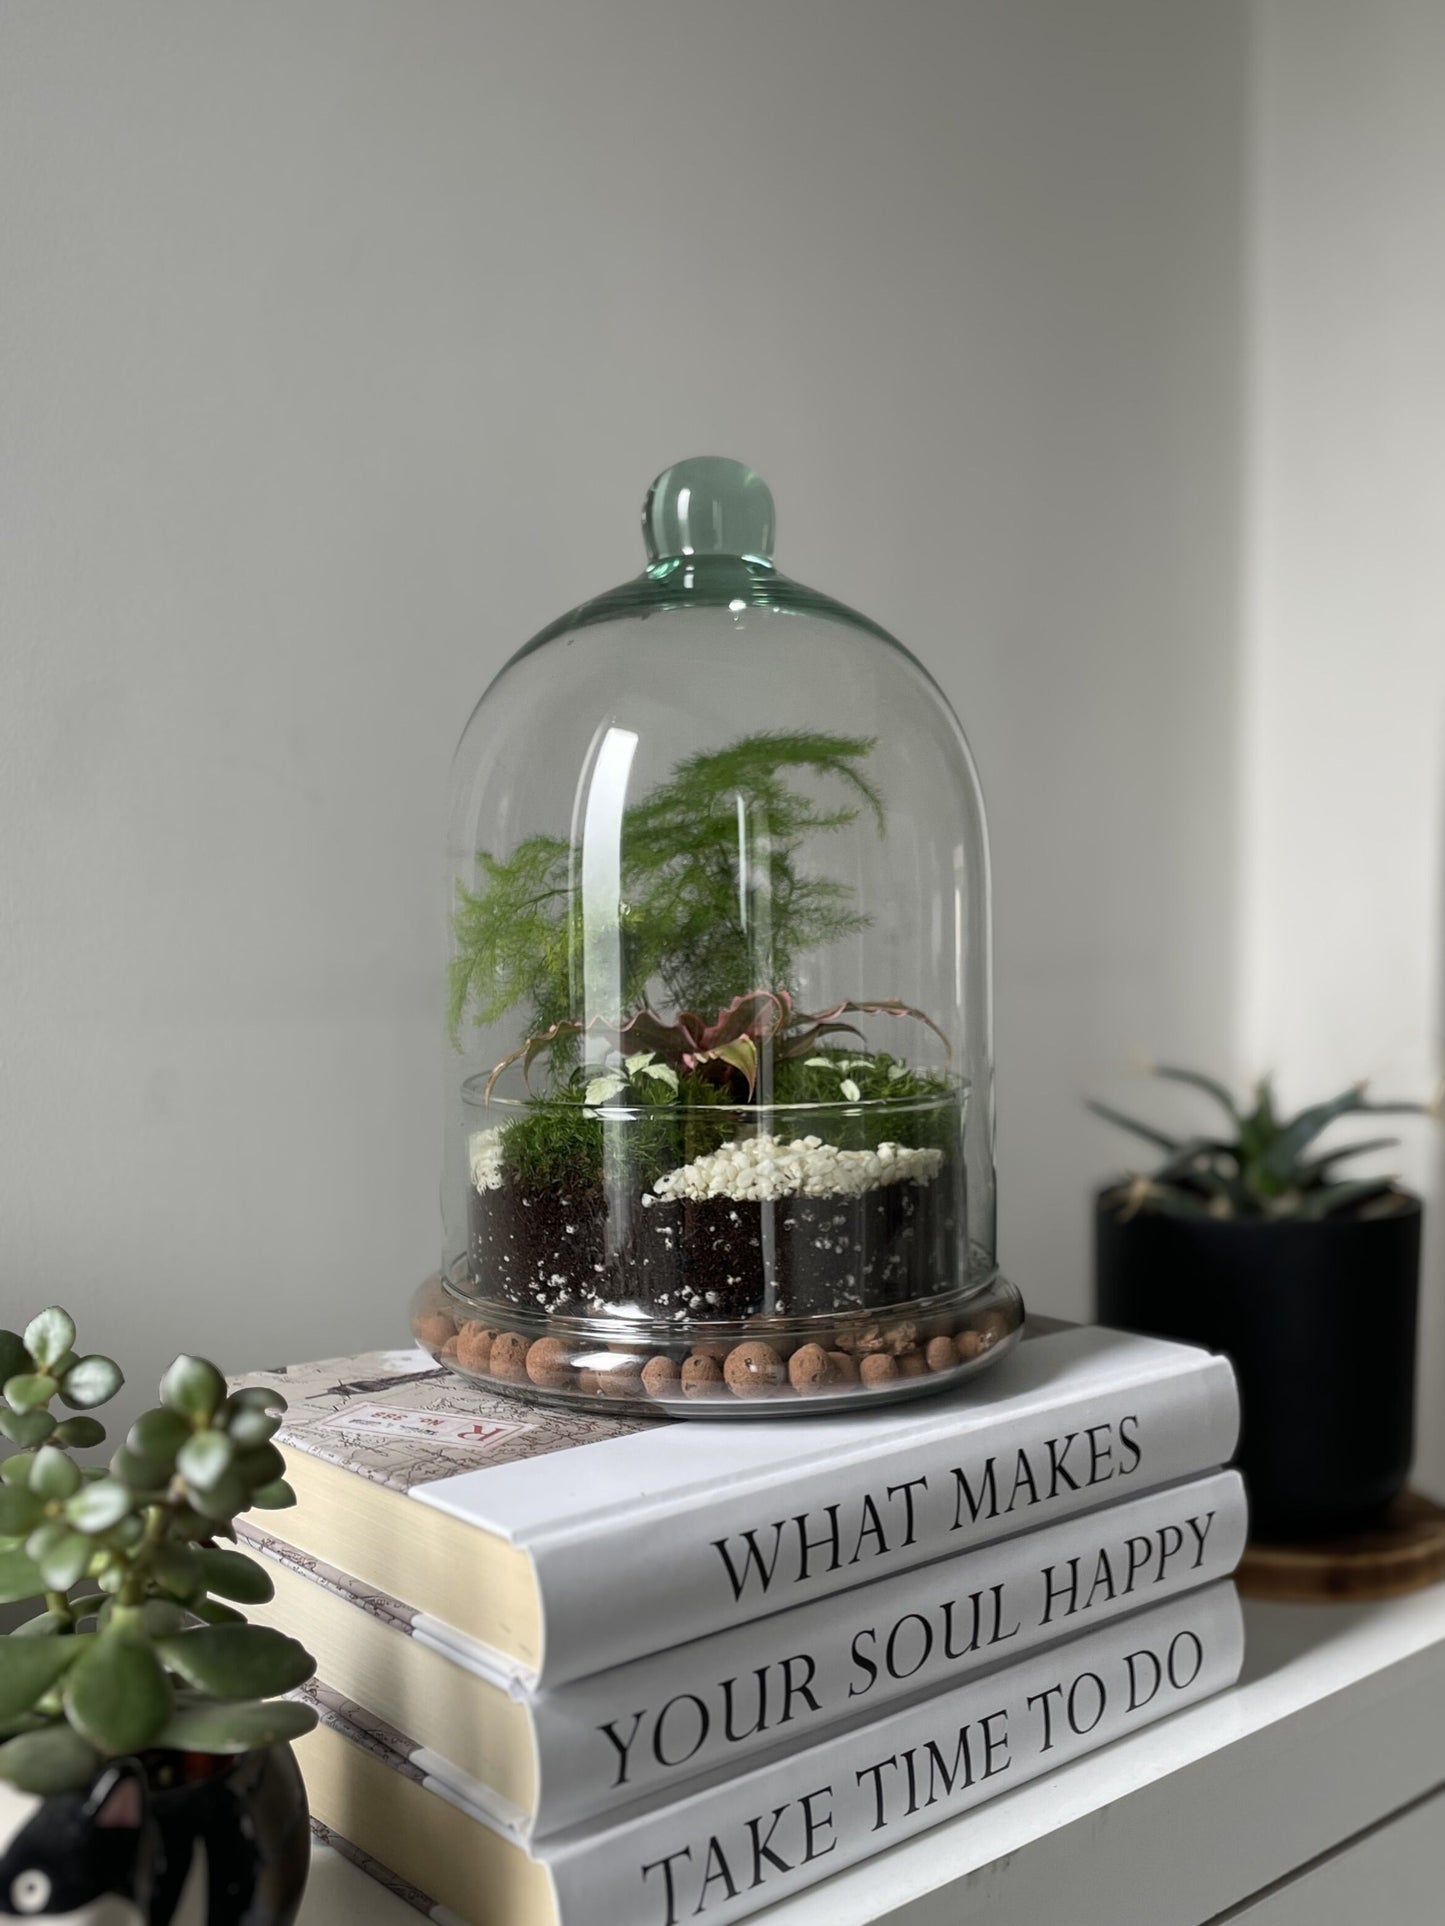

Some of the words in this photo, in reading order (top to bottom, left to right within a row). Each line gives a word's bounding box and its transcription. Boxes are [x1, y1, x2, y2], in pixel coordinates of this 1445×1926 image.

[457, 1424, 507, 1442] R
[710, 1475, 929, 1603] WHAT
[949, 1415, 1142, 1532] MAKES
[596, 1653, 823, 1790] YOUR
[847, 1583, 1021, 1699] SOUL
[1038, 1511, 1217, 1627] HAPPY
[641, 1785, 838, 1926] TAKE
[855, 1709, 1013, 1832] TIME
[1026, 1672, 1107, 1753] TO
[1122, 1630, 1204, 1714] DO
